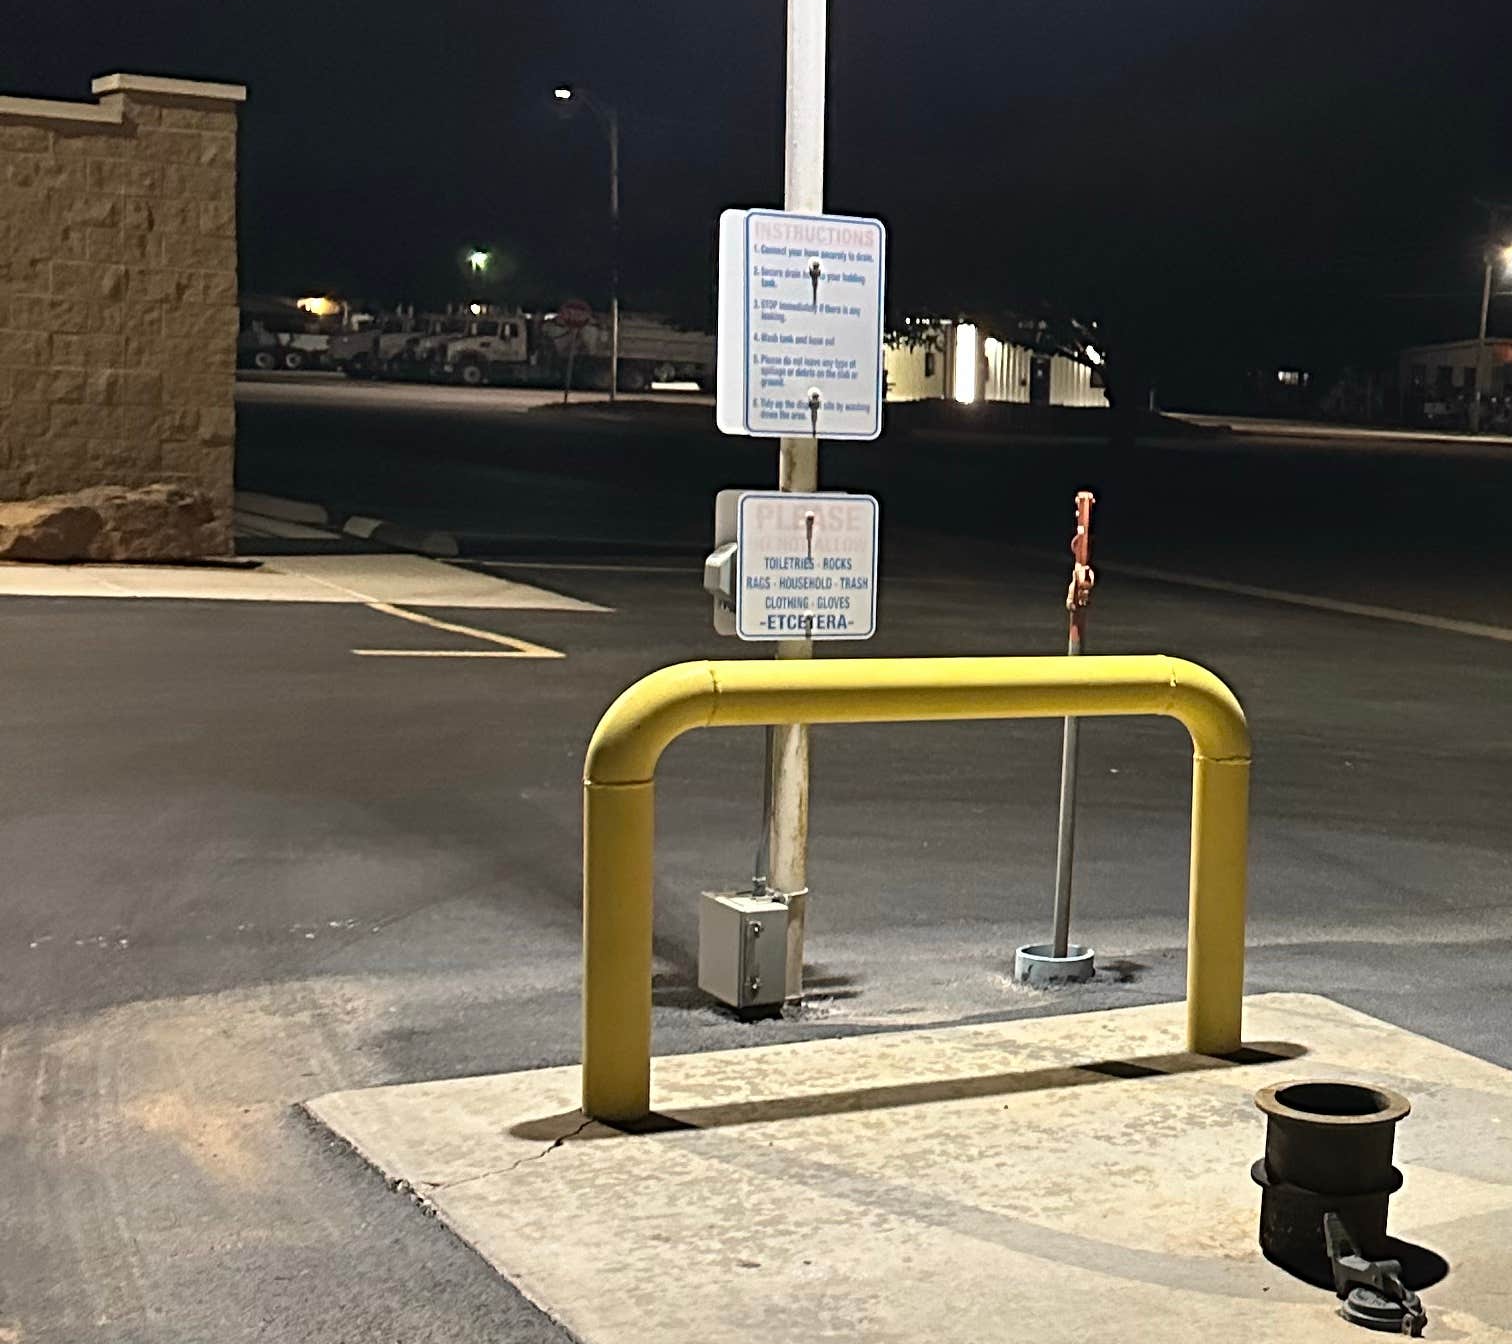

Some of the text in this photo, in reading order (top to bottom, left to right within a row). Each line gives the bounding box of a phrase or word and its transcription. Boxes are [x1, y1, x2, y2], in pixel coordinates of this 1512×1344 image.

[755, 222, 874, 246] INSTRUCTIONS
[761, 244, 786, 254] Connect
[789, 248, 802, 257] your
[761, 299, 778, 309] STOP
[761, 354, 782, 364] Please
[756, 504, 865, 532] PLEASE
[765, 557, 852, 570] TOILETRIES ROCKS
[747, 576, 868, 590] RAGS HOUSEHOLD TRASH
[766, 596, 850, 609] CLOTHING GLOVES
